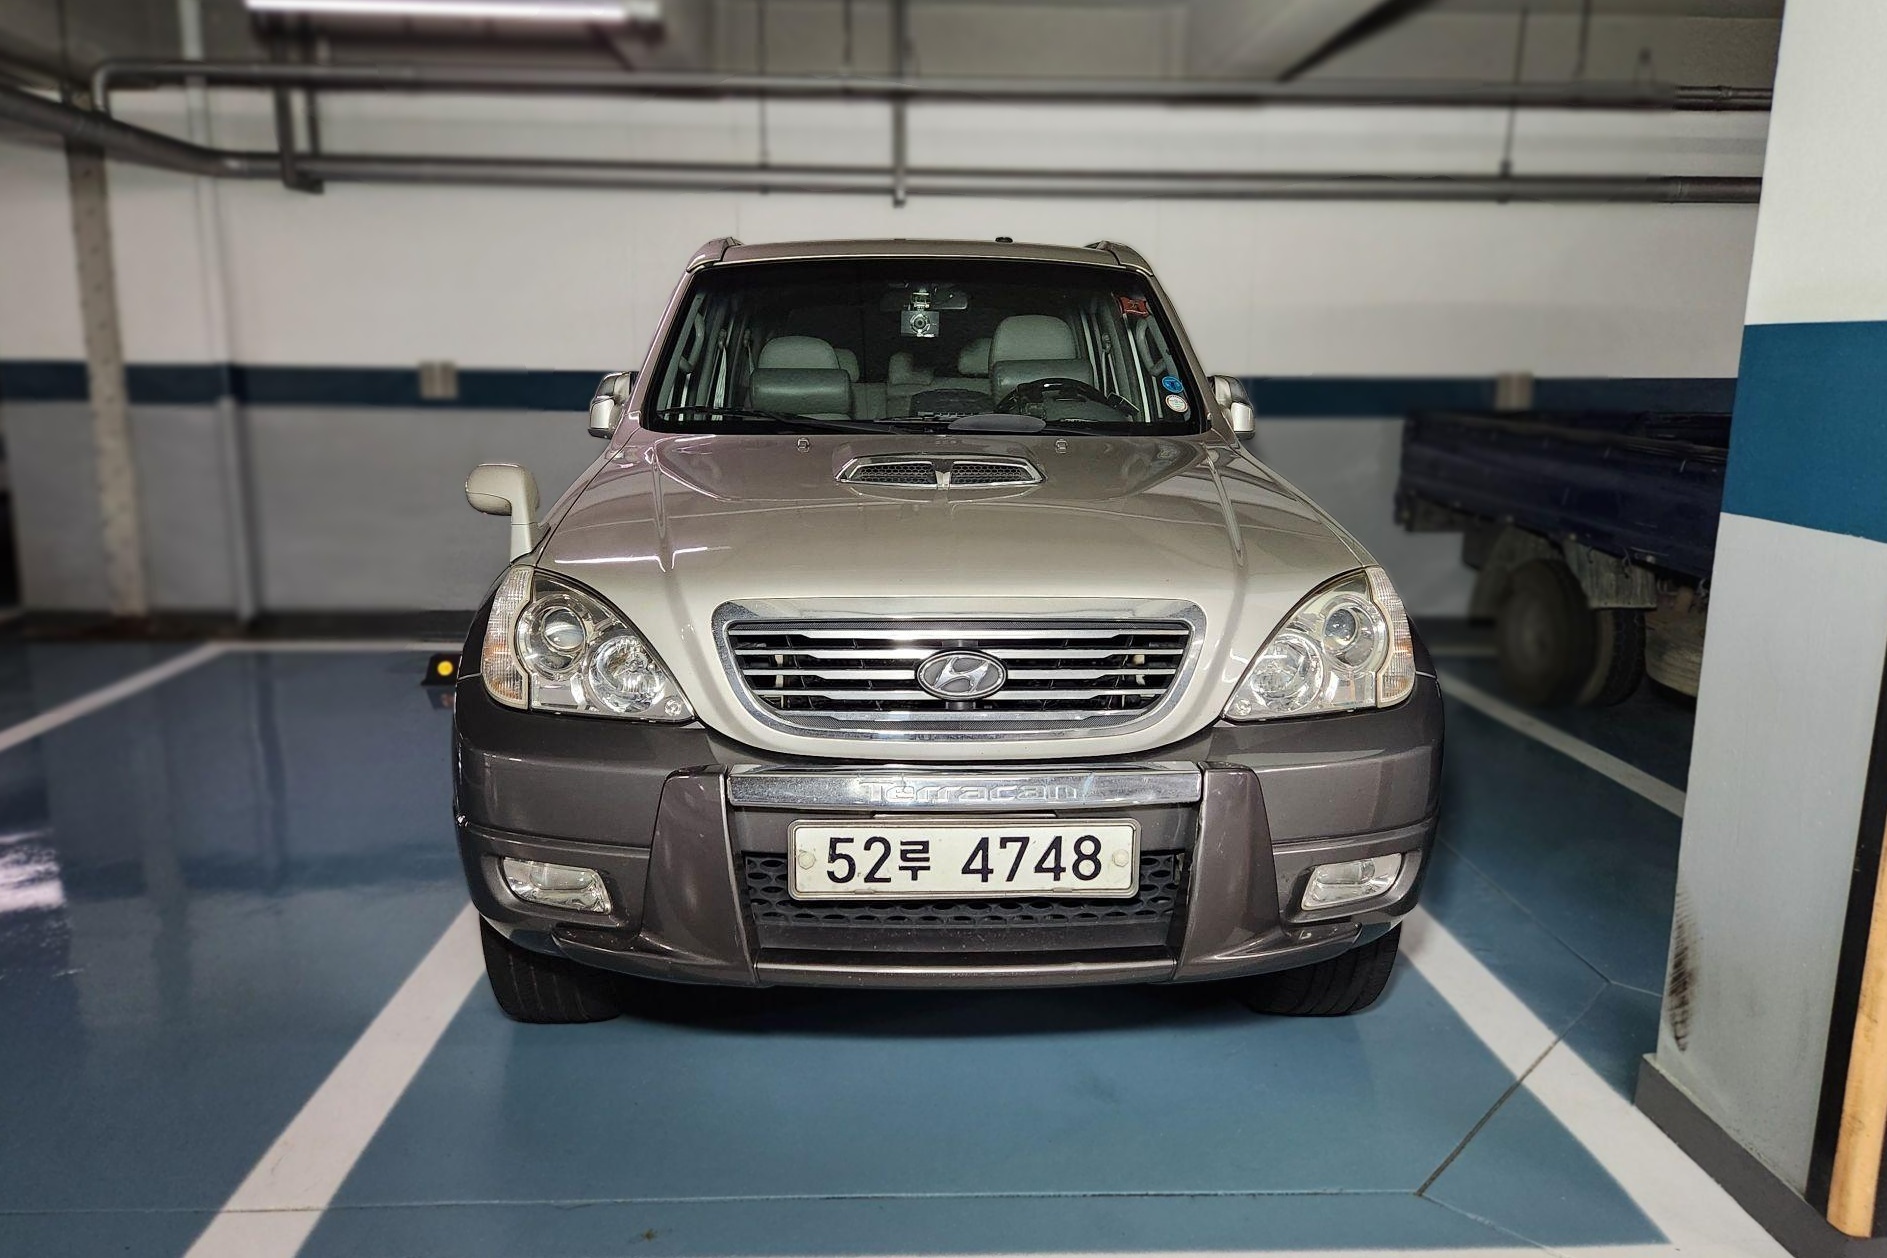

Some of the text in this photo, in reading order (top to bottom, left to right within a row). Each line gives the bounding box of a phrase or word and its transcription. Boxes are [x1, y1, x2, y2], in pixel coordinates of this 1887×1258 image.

[858, 780, 1078, 803] Terracan
[827, 835, 1102, 883] 52루 4748
